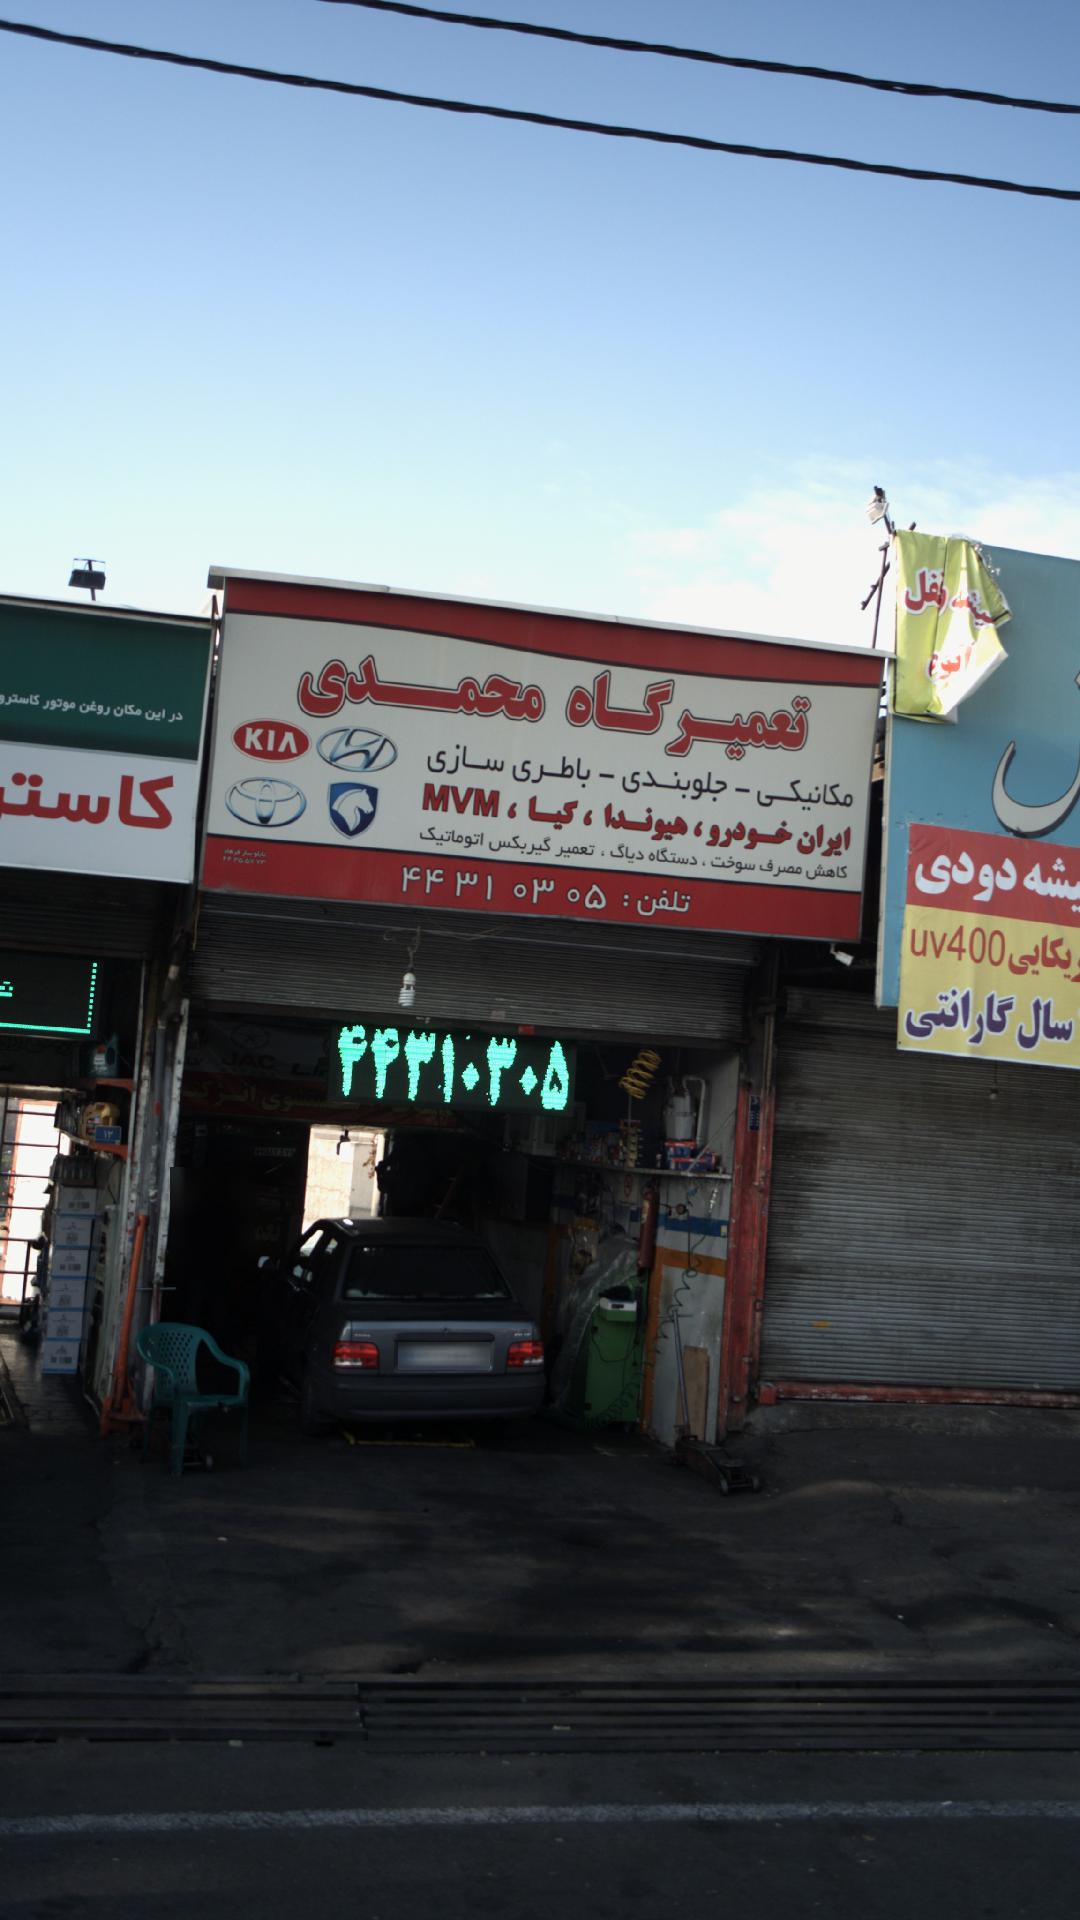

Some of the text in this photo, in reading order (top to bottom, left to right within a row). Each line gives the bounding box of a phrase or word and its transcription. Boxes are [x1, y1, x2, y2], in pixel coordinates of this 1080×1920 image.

[298, 655, 545, 722] محمدی
[0, 693, 184, 723] در این مکان روغن موتور کاسترو
[244, 727, 299, 754] KIA
[427, 744, 504, 774] سازی
[512, 756, 591, 789] باطری
[0, 772, 174, 830] کاست
[422, 783, 500, 818] MVM
[622, 770, 728, 802] جلوبندی
[757, 780, 853, 811] مکانیکی
[419, 827, 484, 849] اتوماتیک
[489, 836, 551, 855] گیربکس
[555, 843, 595, 858] تعمیر
[796, 823, 852, 857] ایران
[649, 849, 698, 866] دستگاه
[710, 856, 755, 874] سوخت
[759, 859, 802, 877] مصرف
[806, 865, 848, 880] کاهش
[915, 852, 1080, 913] یشه دودی
[905, 989, 1073, 1049] سال گارانتی
